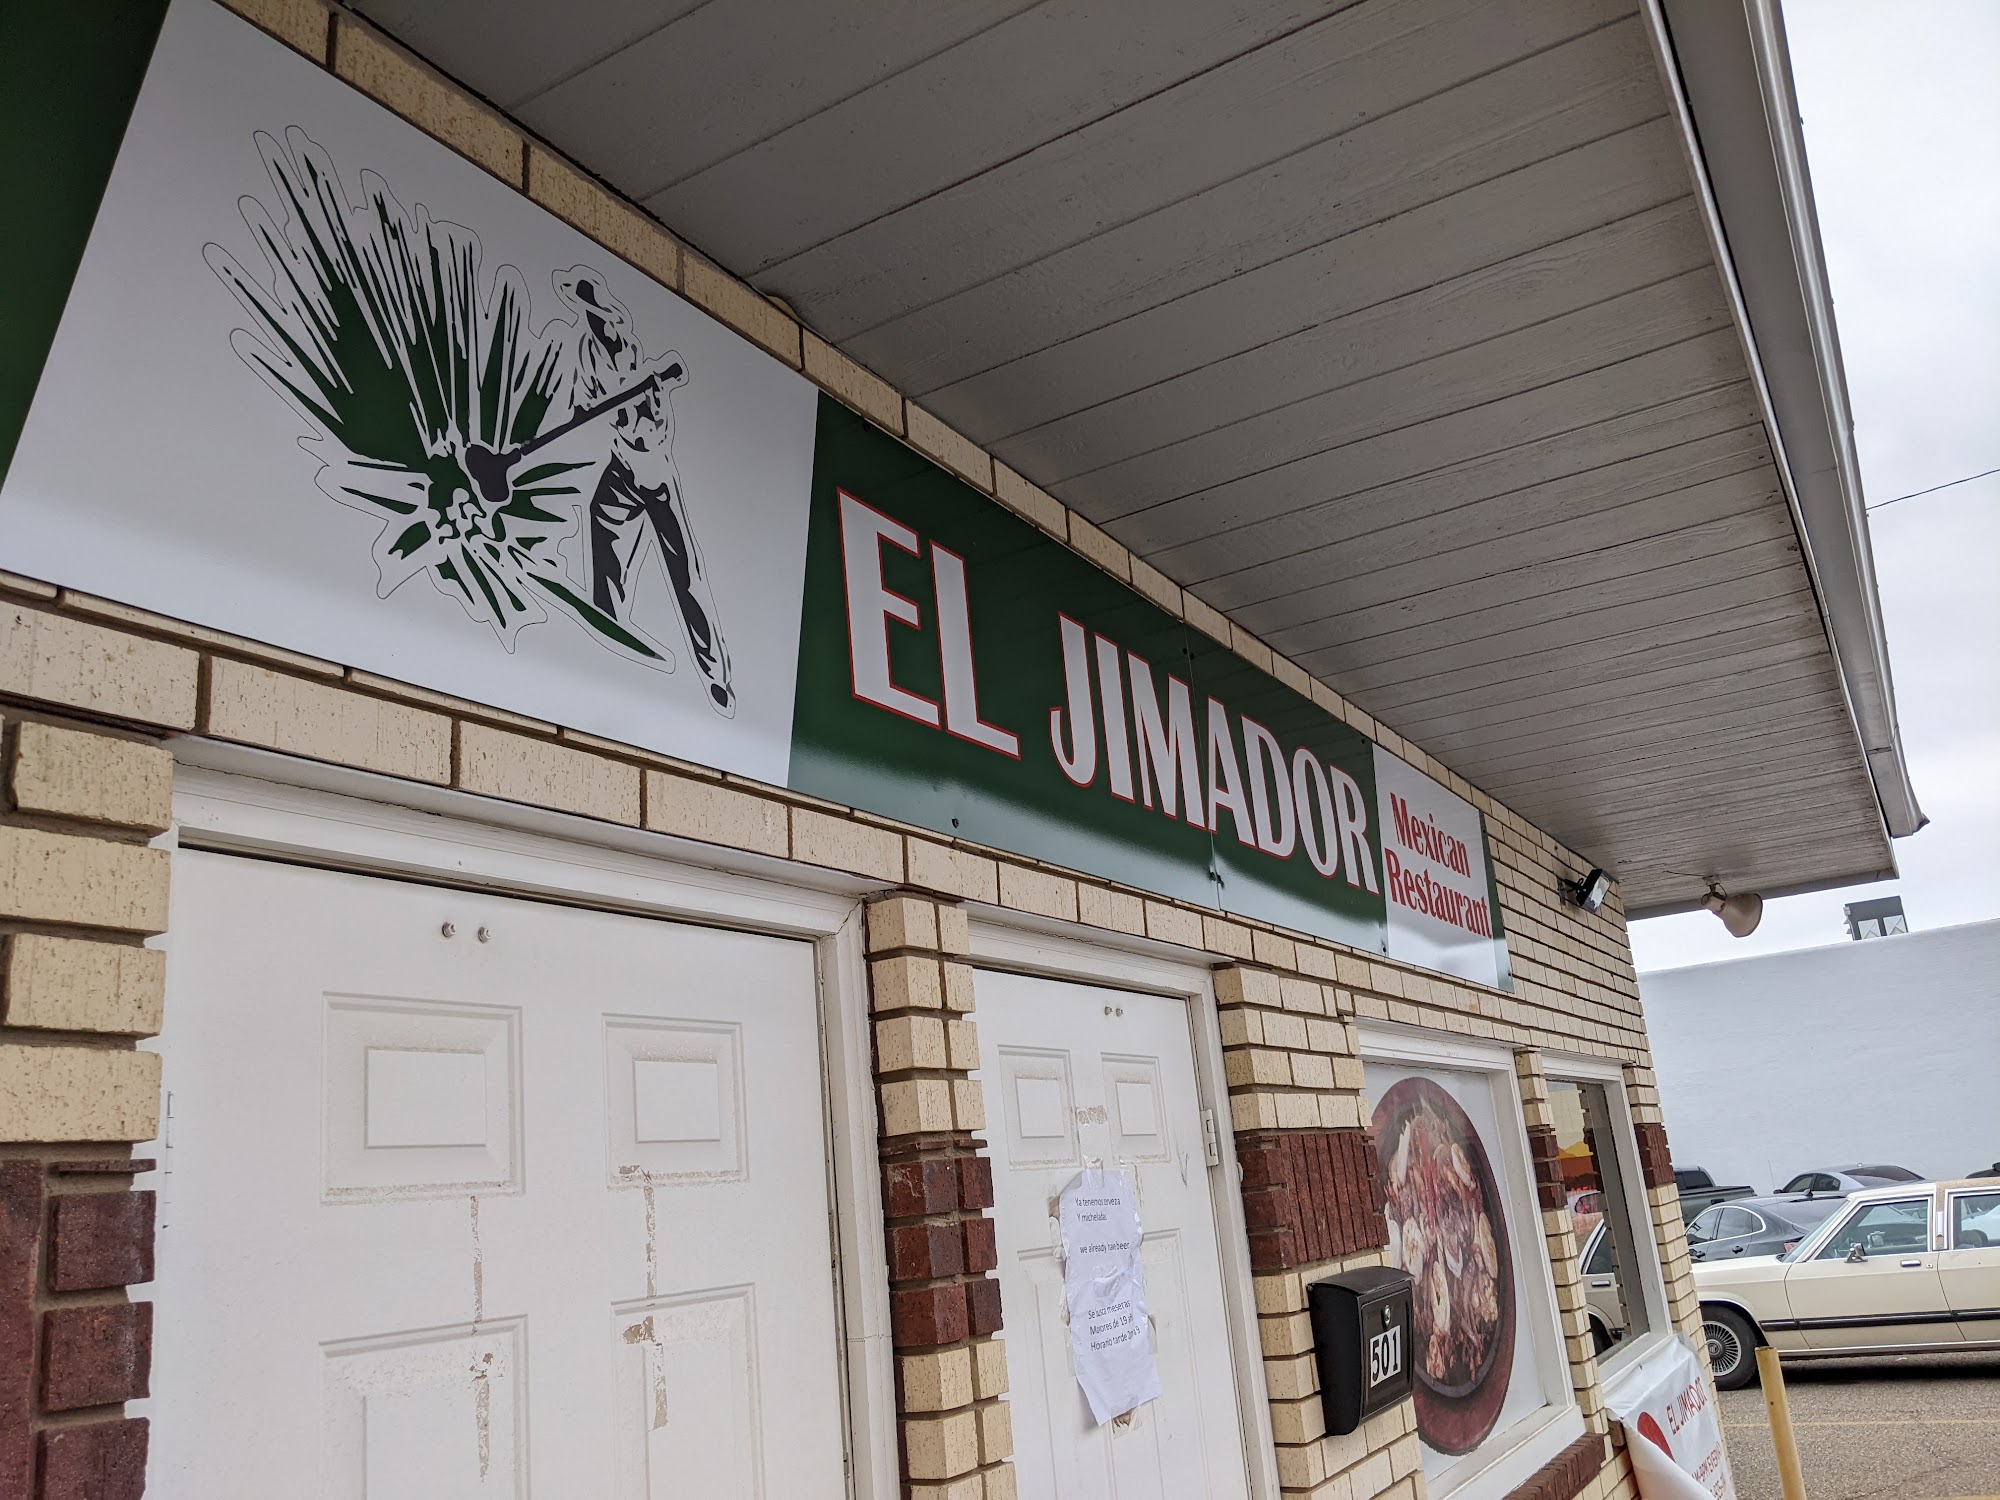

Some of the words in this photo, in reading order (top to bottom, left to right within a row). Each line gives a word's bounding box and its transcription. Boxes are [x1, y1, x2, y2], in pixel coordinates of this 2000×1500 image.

[837, 487, 1021, 760] EL
[1049, 611, 1380, 896] JIMADOR
[1390, 791, 1471, 879] Mexican
[1384, 846, 1493, 940] Restaurant
[1074, 1197, 1082, 1207] Ya
[1089, 1242, 1107, 1253] already
[1087, 1309, 1096, 1320] Se
[1107, 1299, 1131, 1314] meseras
[1112, 1318, 1120, 1329] de
[1119, 1315, 1128, 1326] 19
[1090, 1337, 1113, 1352] Horario
[1112, 1332, 1128, 1345] tarde
[1372, 1329, 1399, 1383] 501
[1666, 1403, 1681, 1436] EL
